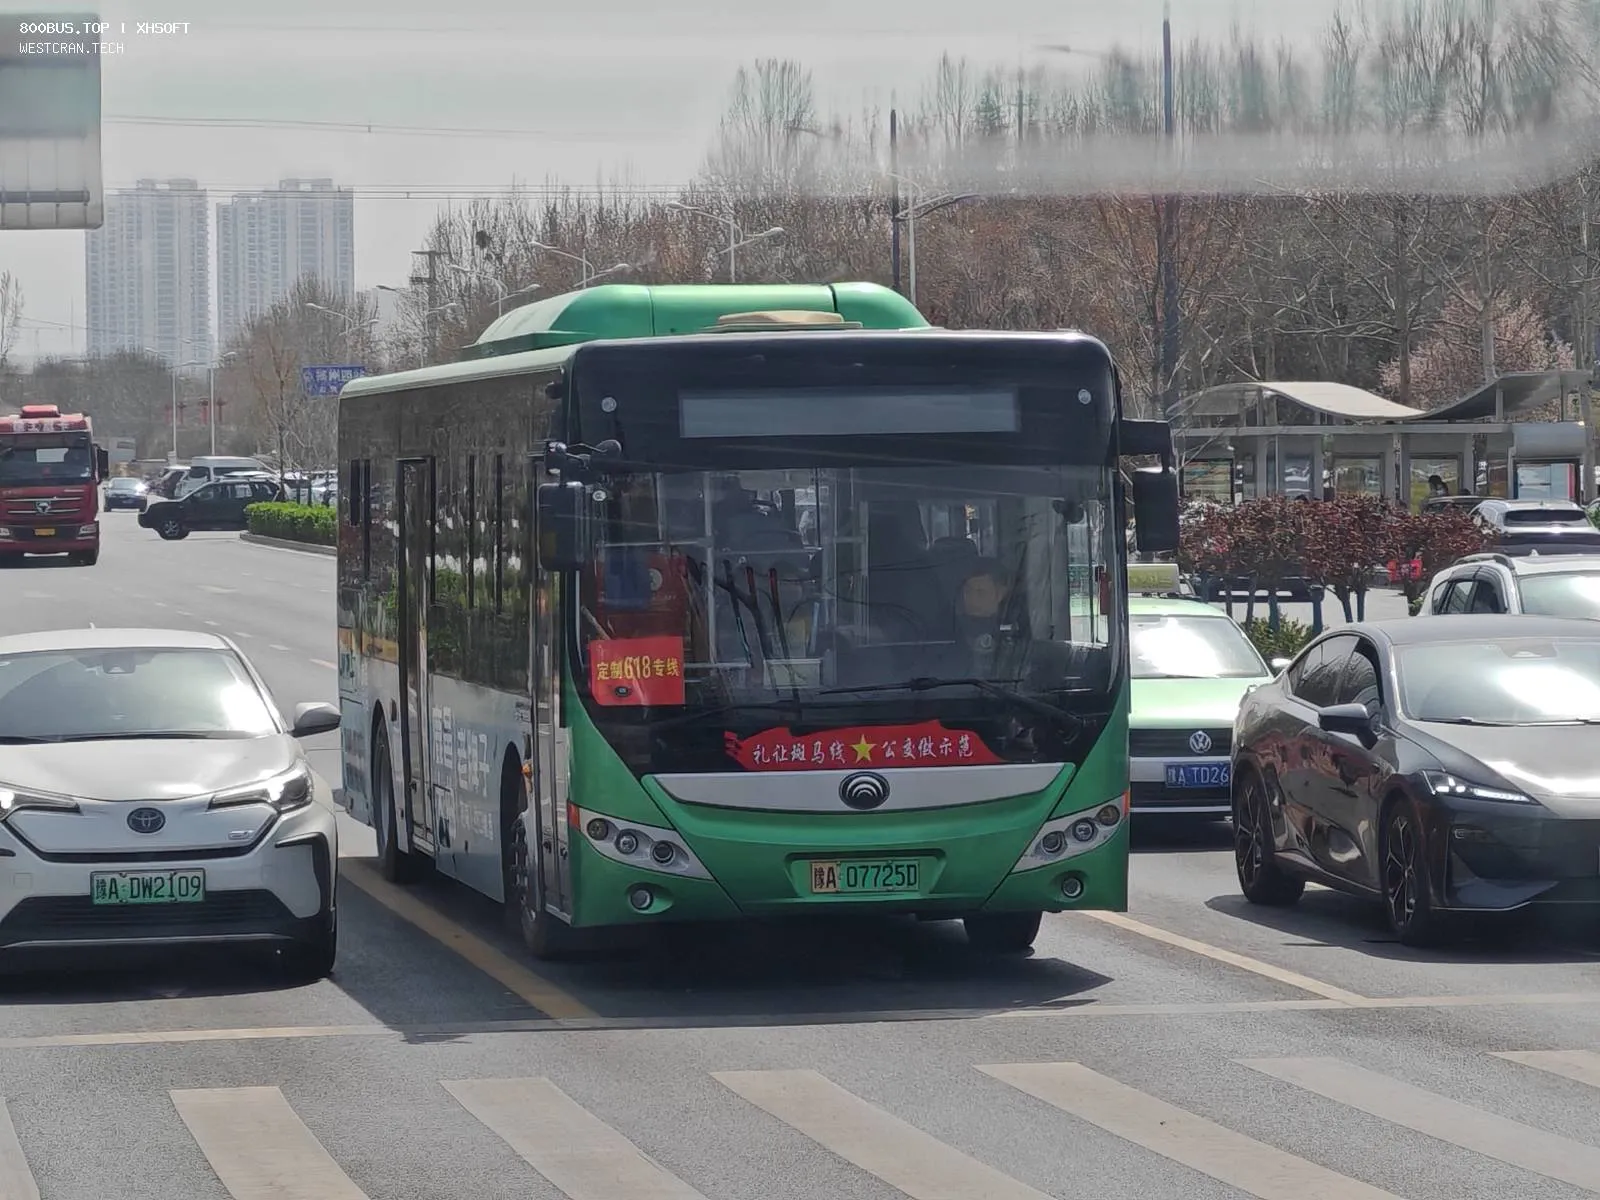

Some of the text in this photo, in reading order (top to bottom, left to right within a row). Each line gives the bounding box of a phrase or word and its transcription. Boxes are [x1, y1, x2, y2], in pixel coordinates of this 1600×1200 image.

[596, 655, 680, 680] 定制618专线
[752, 734, 973, 765] 礼让斑马线 公交做示范
